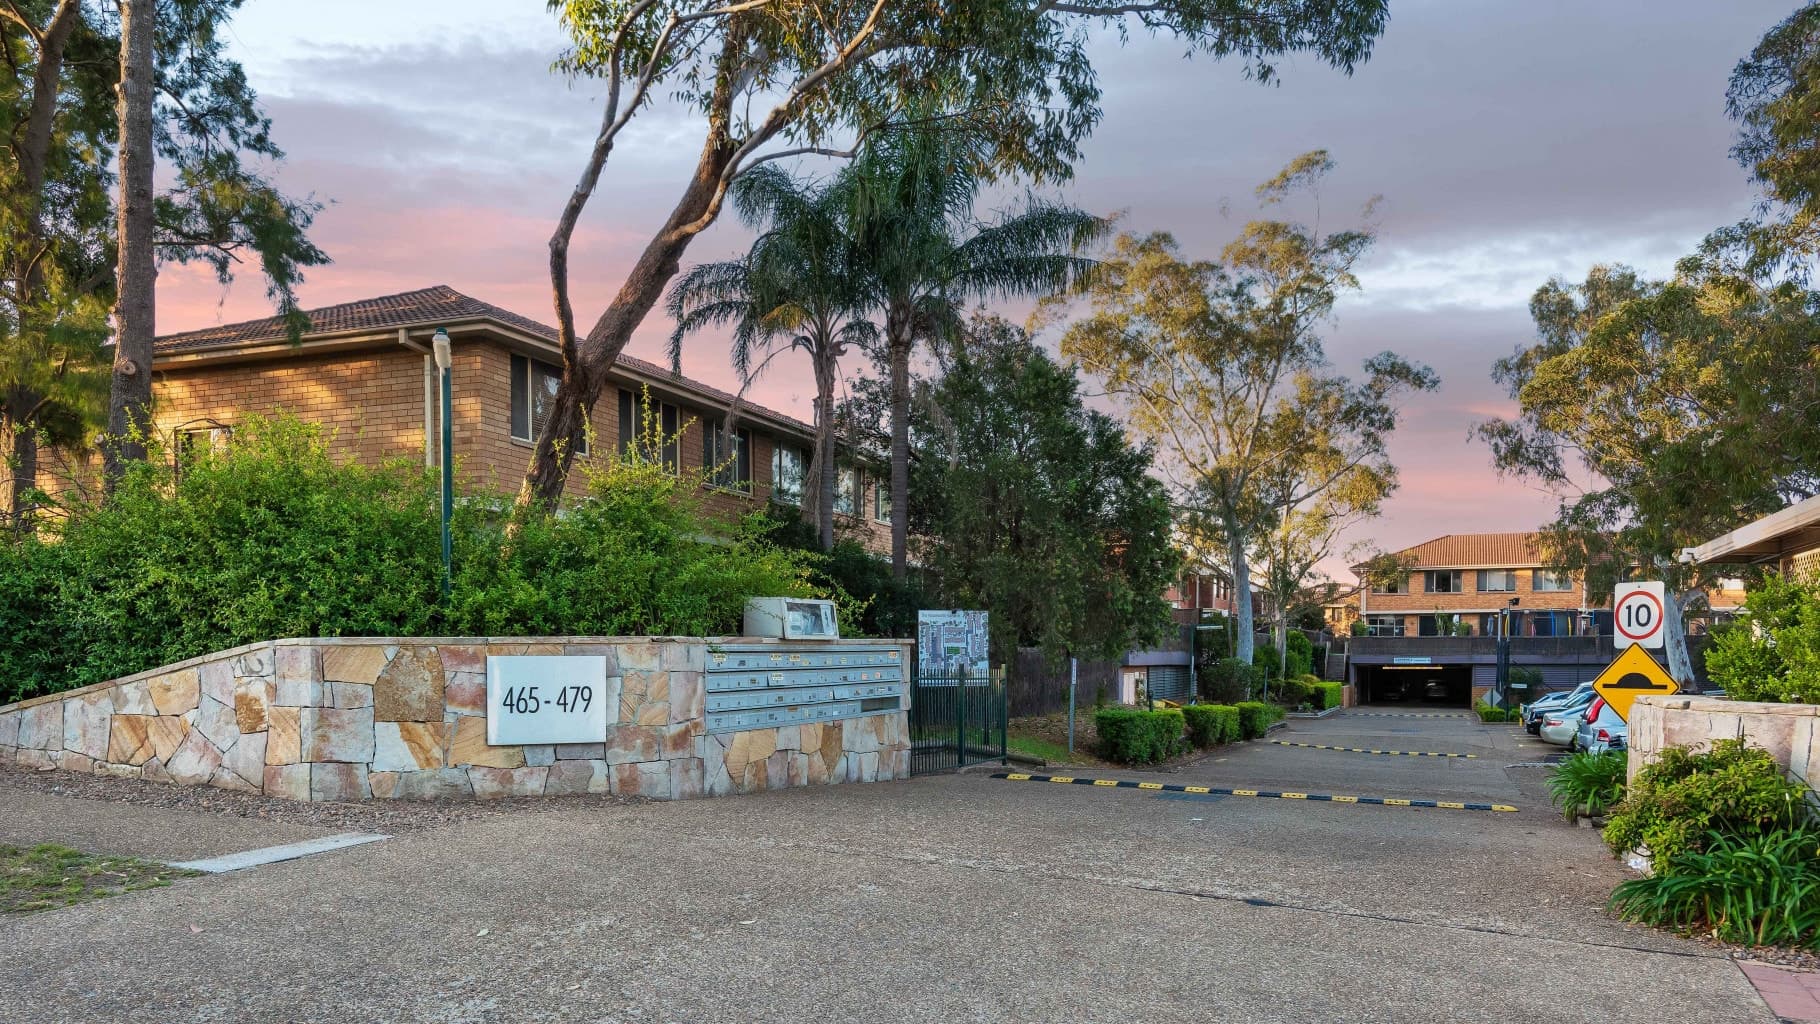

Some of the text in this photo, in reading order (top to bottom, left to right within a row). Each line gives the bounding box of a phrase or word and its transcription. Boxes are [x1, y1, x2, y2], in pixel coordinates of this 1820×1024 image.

[1625, 604, 1652, 627] 10
[502, 686, 540, 714] 465
[556, 686, 594, 713] 479
